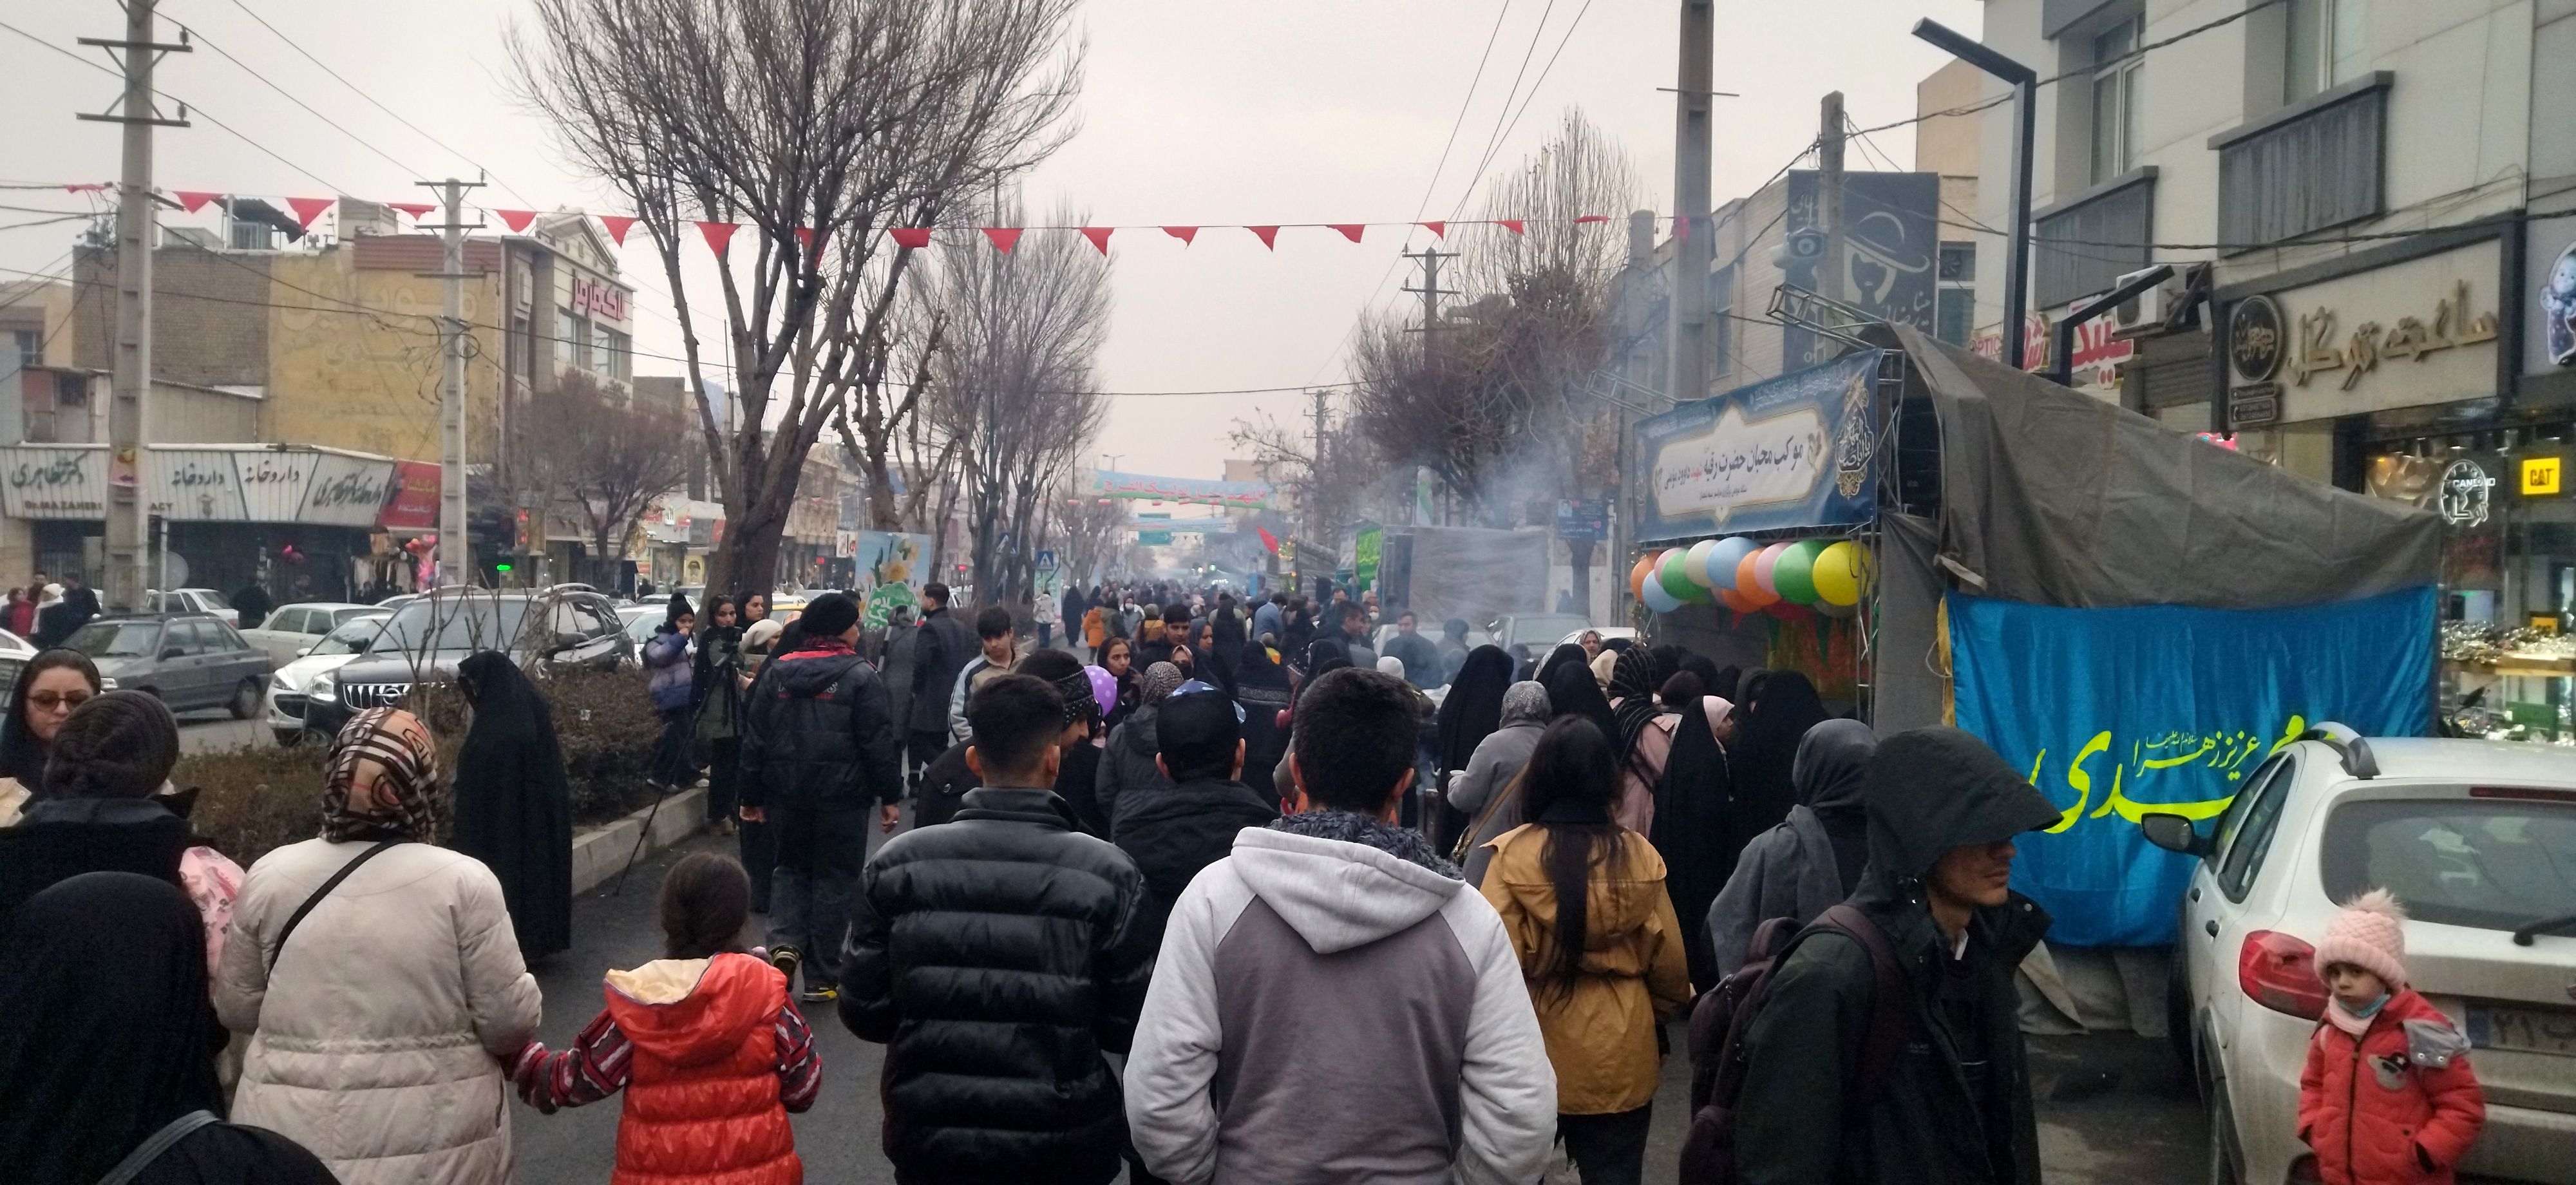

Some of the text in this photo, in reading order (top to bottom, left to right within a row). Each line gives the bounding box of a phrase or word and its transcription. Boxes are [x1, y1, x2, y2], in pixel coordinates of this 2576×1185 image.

[1774, 435, 1803, 471] موکب
[172, 462, 224, 486] داروخانه
[245, 460, 299, 483] داروخانه
[2530, 467, 2555, 487] CAT
